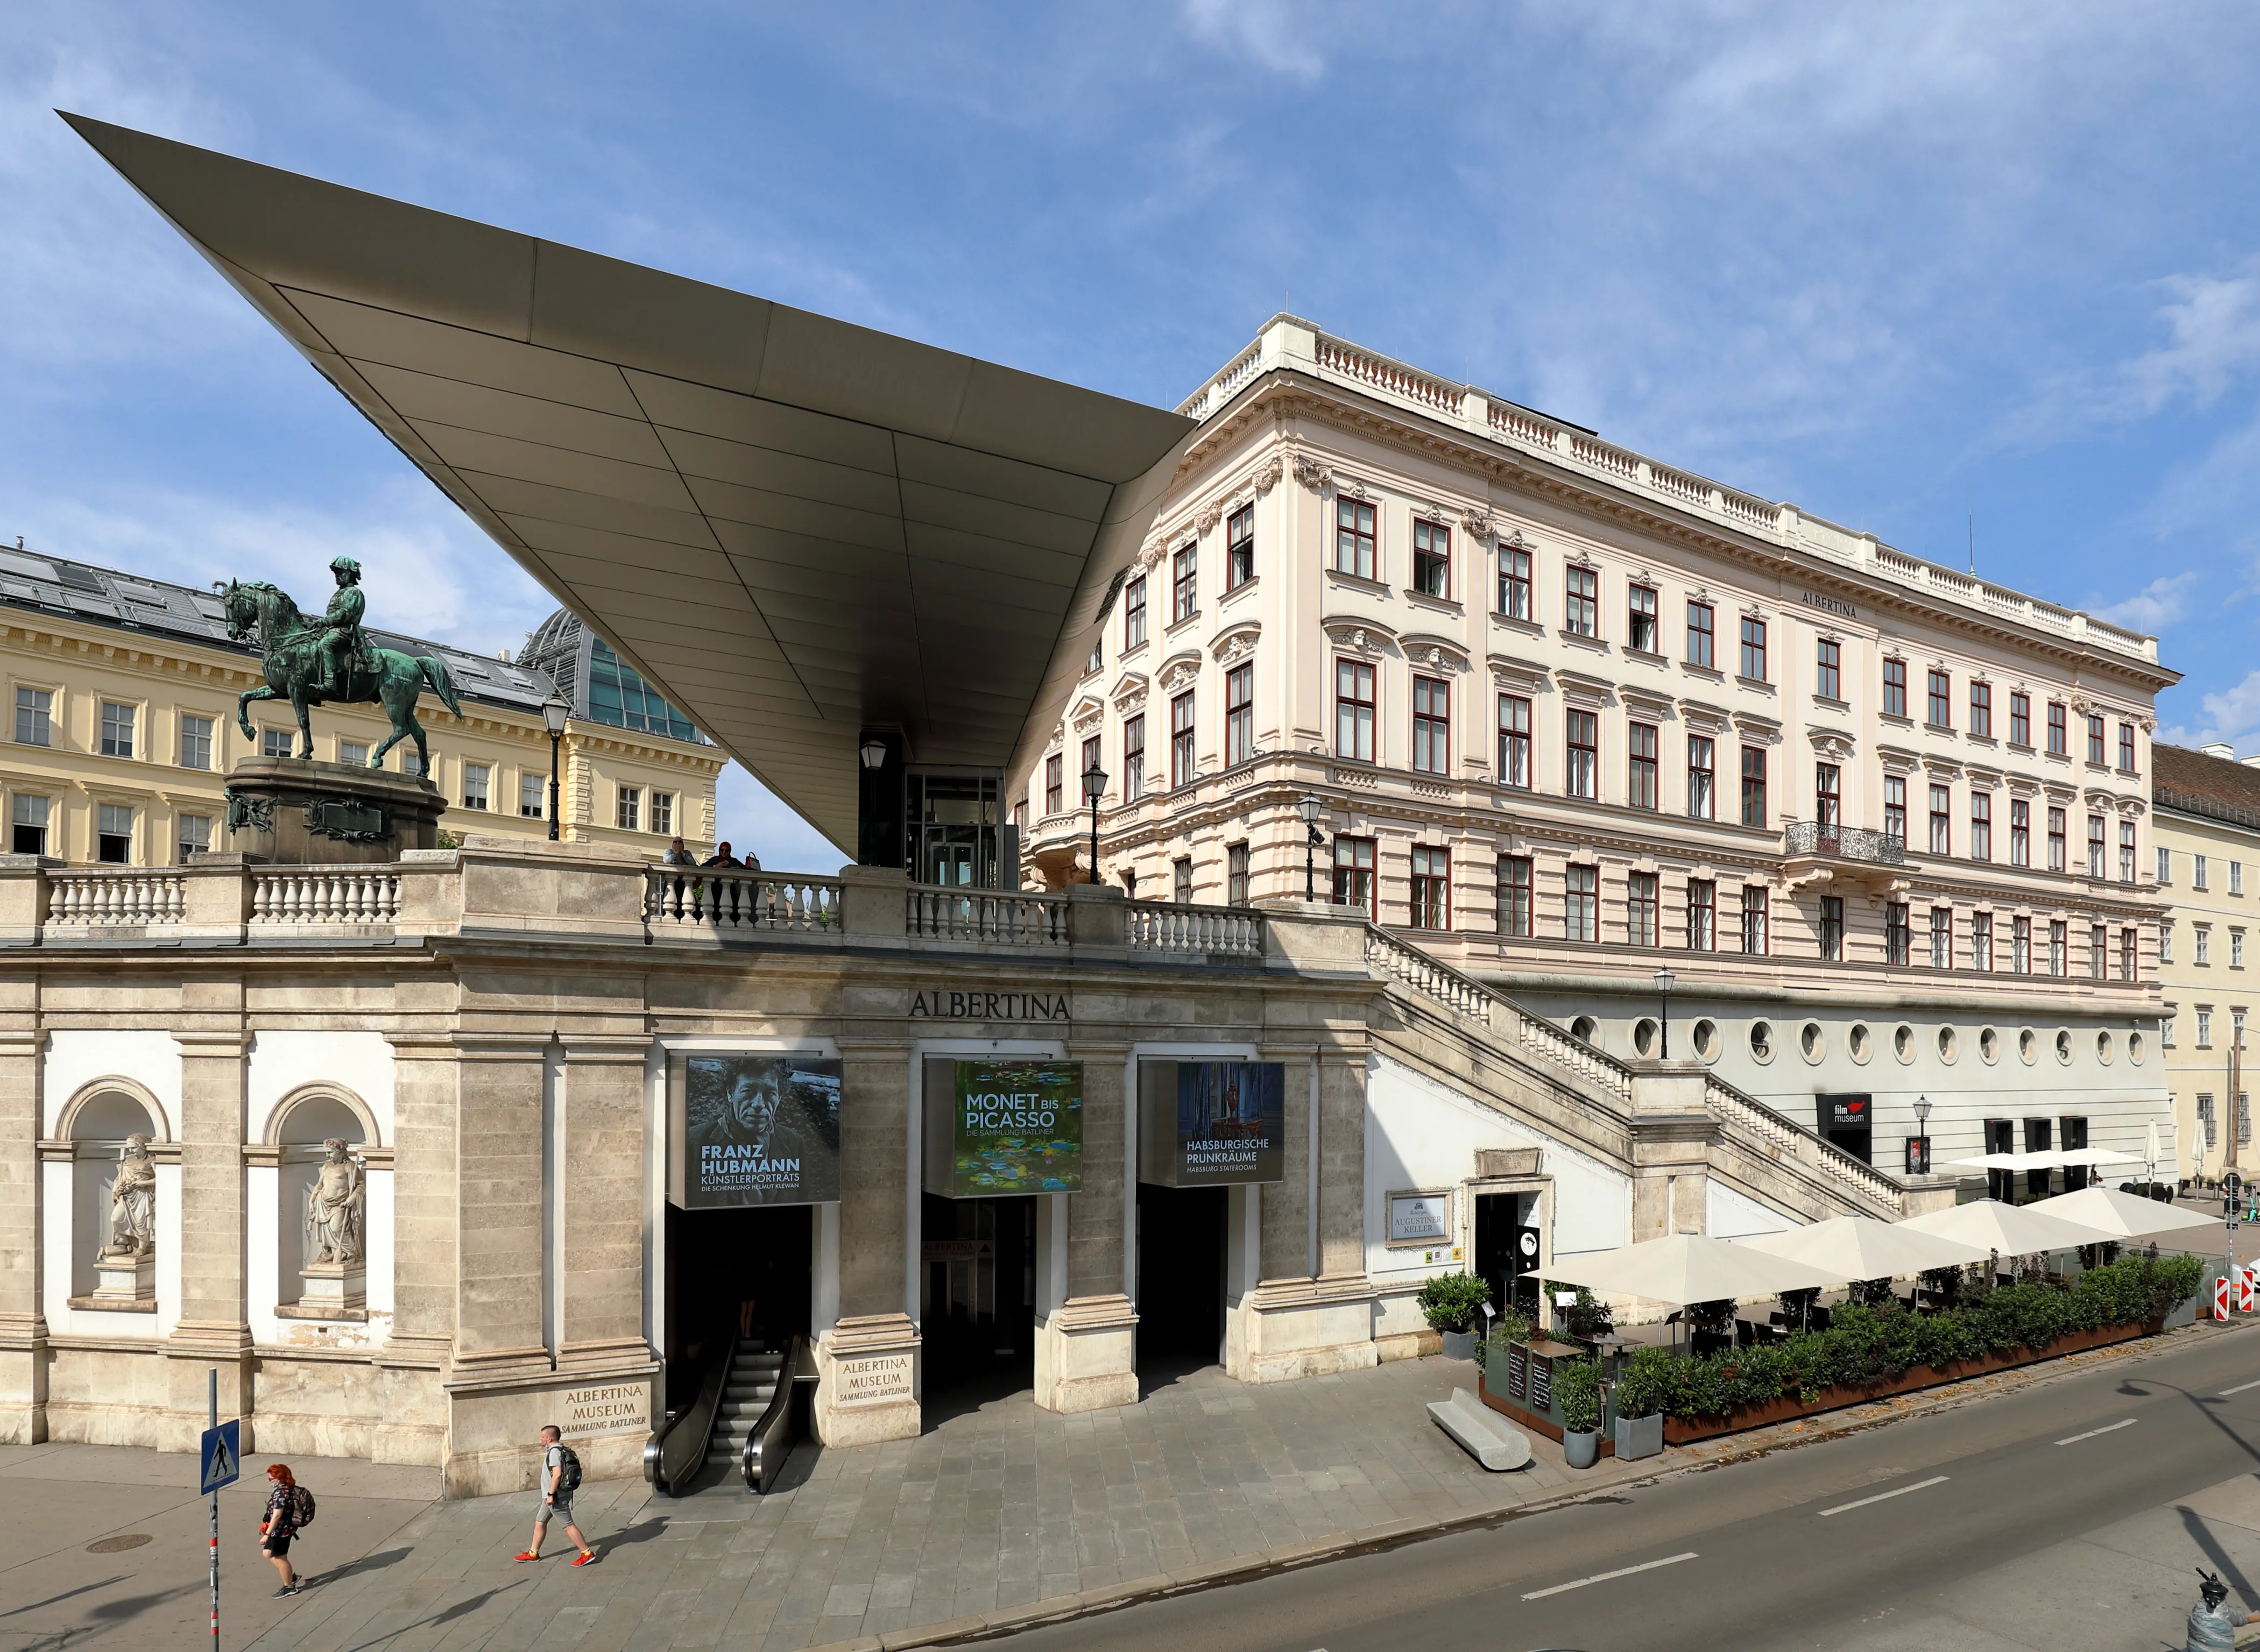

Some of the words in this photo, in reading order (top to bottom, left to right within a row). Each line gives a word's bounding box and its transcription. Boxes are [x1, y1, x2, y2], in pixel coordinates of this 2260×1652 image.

[1802, 592, 1856, 619] ALBERTINA
[908, 991, 1071, 1019] ALBERTINA
[966, 1094, 1039, 1110] MONET
[1041, 1100, 1059, 1109] BIS
[1834, 1104, 1848, 1115] film
[966, 1111, 1055, 1129] PICASSO
[1834, 1115, 1864, 1123] museum
[701, 1144, 764, 1159] FRANZ
[1187, 1139, 1269, 1151] HABSBURGISCHE
[1187, 1150, 1257, 1164] PRUNKRÄUME
[701, 1158, 800, 1174] HUBMANN
[701, 1171, 800, 1185] KÜNSTLERPORTRÄTS
[1395, 1216, 1442, 1225] AUGUSTINER
[1404, 1225, 1432, 1233] KELLER
[923, 1243, 973, 1251] ALBERTINA
[843, 1358, 908, 1374] ALBERTINA
[849, 1373, 902, 1389] MUSEUM
[566, 1386, 644, 1404] ALBERTINA
[839, 1390, 878, 1402] SAMMLUNG
[880, 1386, 910, 1396] BATLINER
[573, 1403, 636, 1420] MUSEUM
[561, 1421, 608, 1434] SAMMLUNG
[609, 1416, 646, 1428] BATLINER
